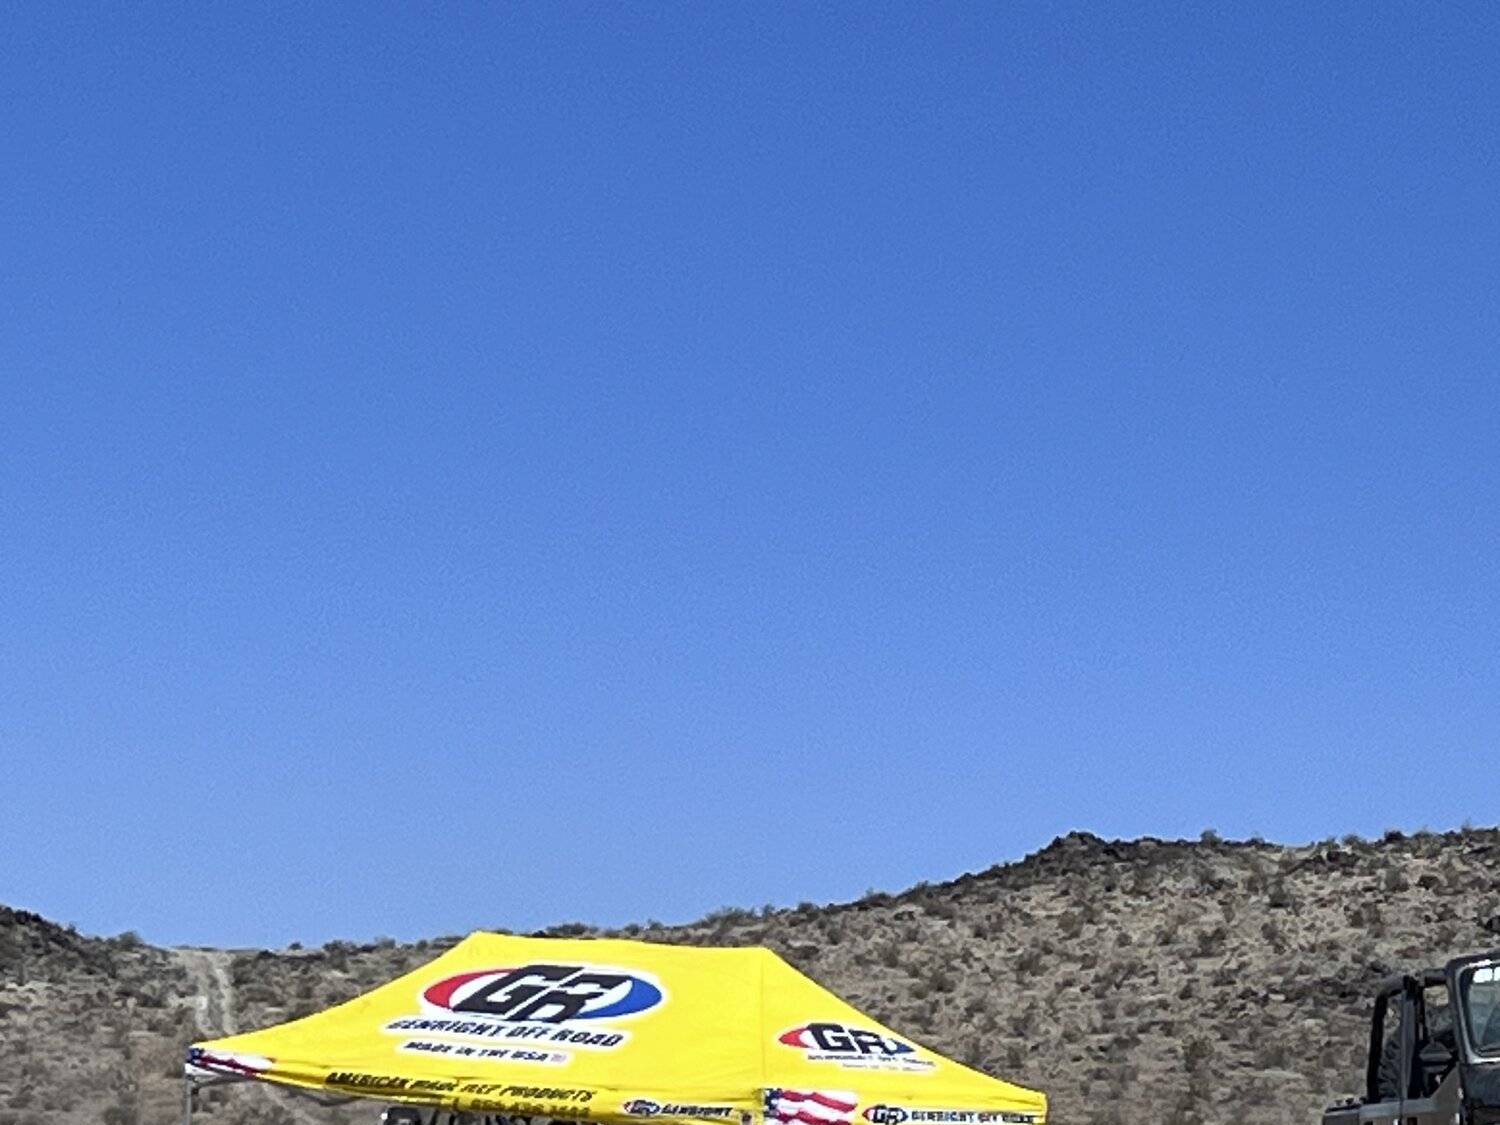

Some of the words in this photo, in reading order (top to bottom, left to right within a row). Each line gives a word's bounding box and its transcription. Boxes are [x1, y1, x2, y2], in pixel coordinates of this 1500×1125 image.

[451, 964, 634, 1024] GR
[387, 1018, 504, 1038] GENRIGHT
[505, 1026, 552, 1039] OFF
[550, 1028, 624, 1047] ROAD
[806, 1023, 893, 1055] GR
